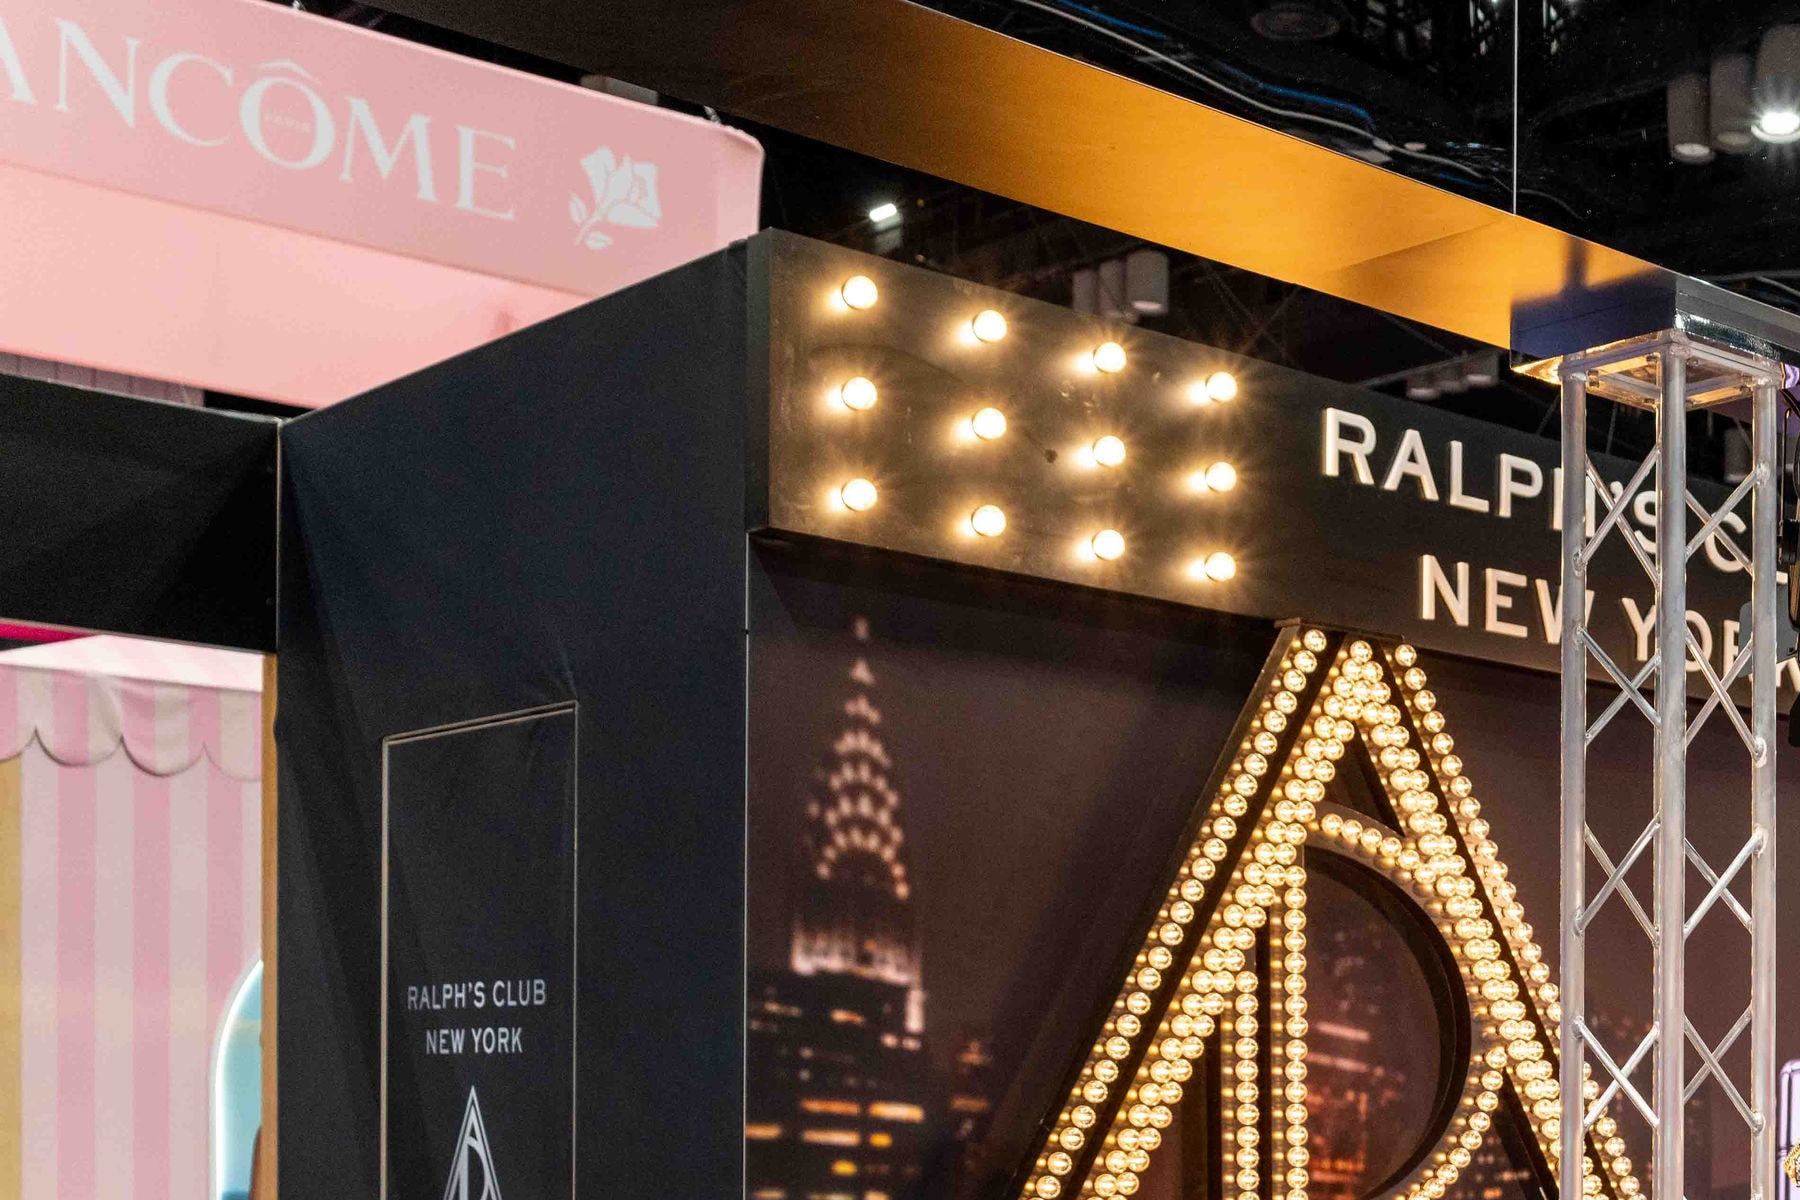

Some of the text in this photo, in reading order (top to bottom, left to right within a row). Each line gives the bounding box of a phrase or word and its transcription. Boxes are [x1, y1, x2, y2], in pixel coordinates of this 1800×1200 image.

[407, 978, 547, 1011] RALPH'S CLUB
[425, 1026, 524, 1055] NEW YORK
